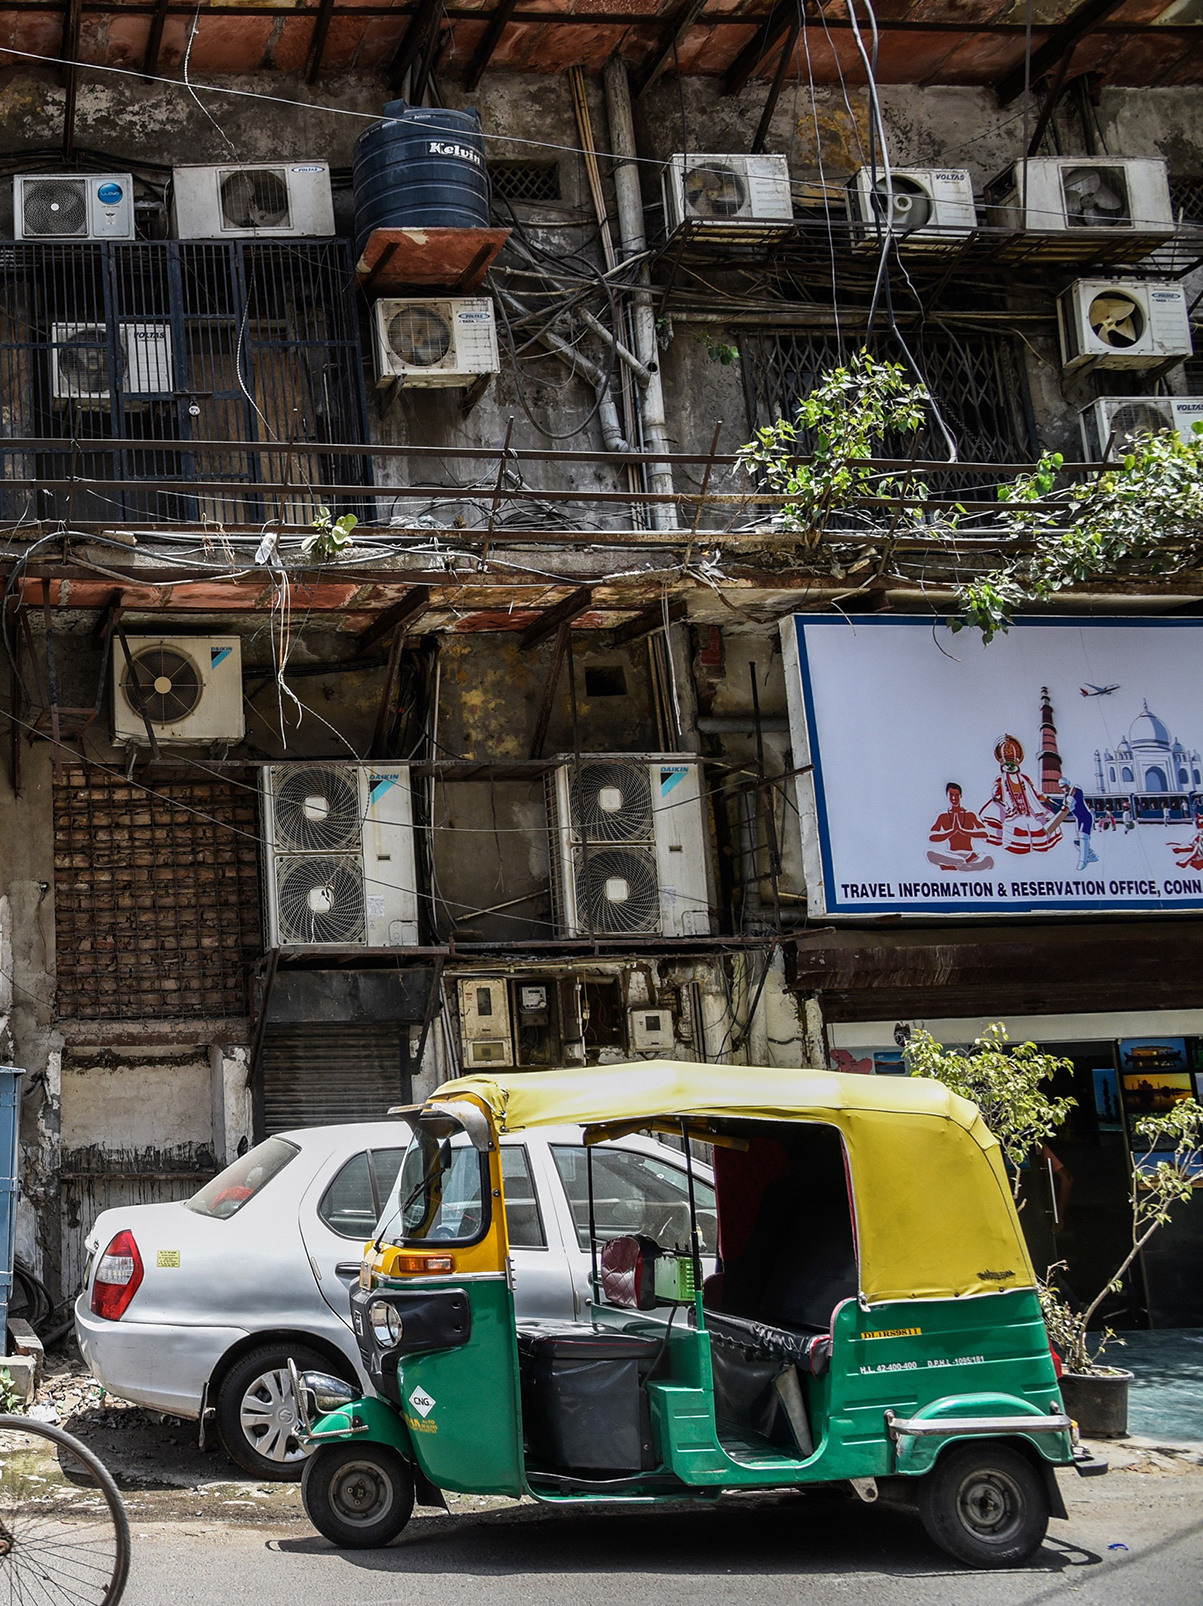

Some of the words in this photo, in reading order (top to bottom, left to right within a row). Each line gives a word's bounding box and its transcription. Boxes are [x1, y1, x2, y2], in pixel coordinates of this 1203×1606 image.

[429, 142, 481, 166] Kelvin
[841, 883, 895, 898] TRAVEL
[899, 882, 994, 898] INFORMATION
[997, 882, 1008, 897] &
[1011, 880, 1106, 896] RESERVATION
[1109, 880, 1161, 897] OFFICE,
[413, 1396, 430, 1406] CNG
